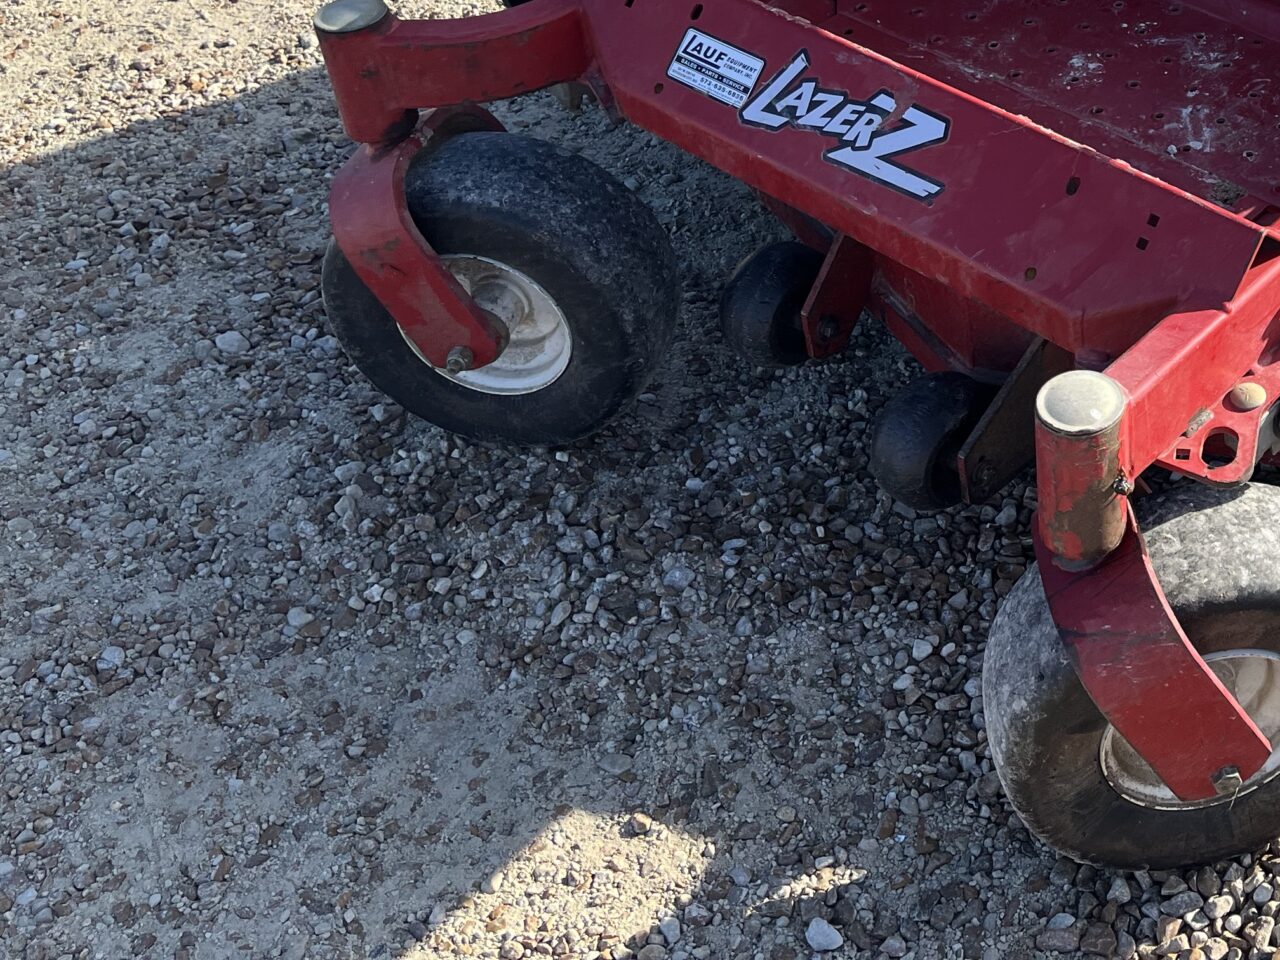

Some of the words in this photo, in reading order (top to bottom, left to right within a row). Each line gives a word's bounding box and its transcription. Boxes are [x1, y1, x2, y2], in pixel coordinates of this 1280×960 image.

[682, 34, 728, 70] LAUF
[726, 56, 758, 74] EQUIPMENT
[680, 58, 698, 69] SALES
[701, 66, 719, 79] PARTS
[722, 77, 745, 92] SERVICE
[826, 105, 947, 198] Z
